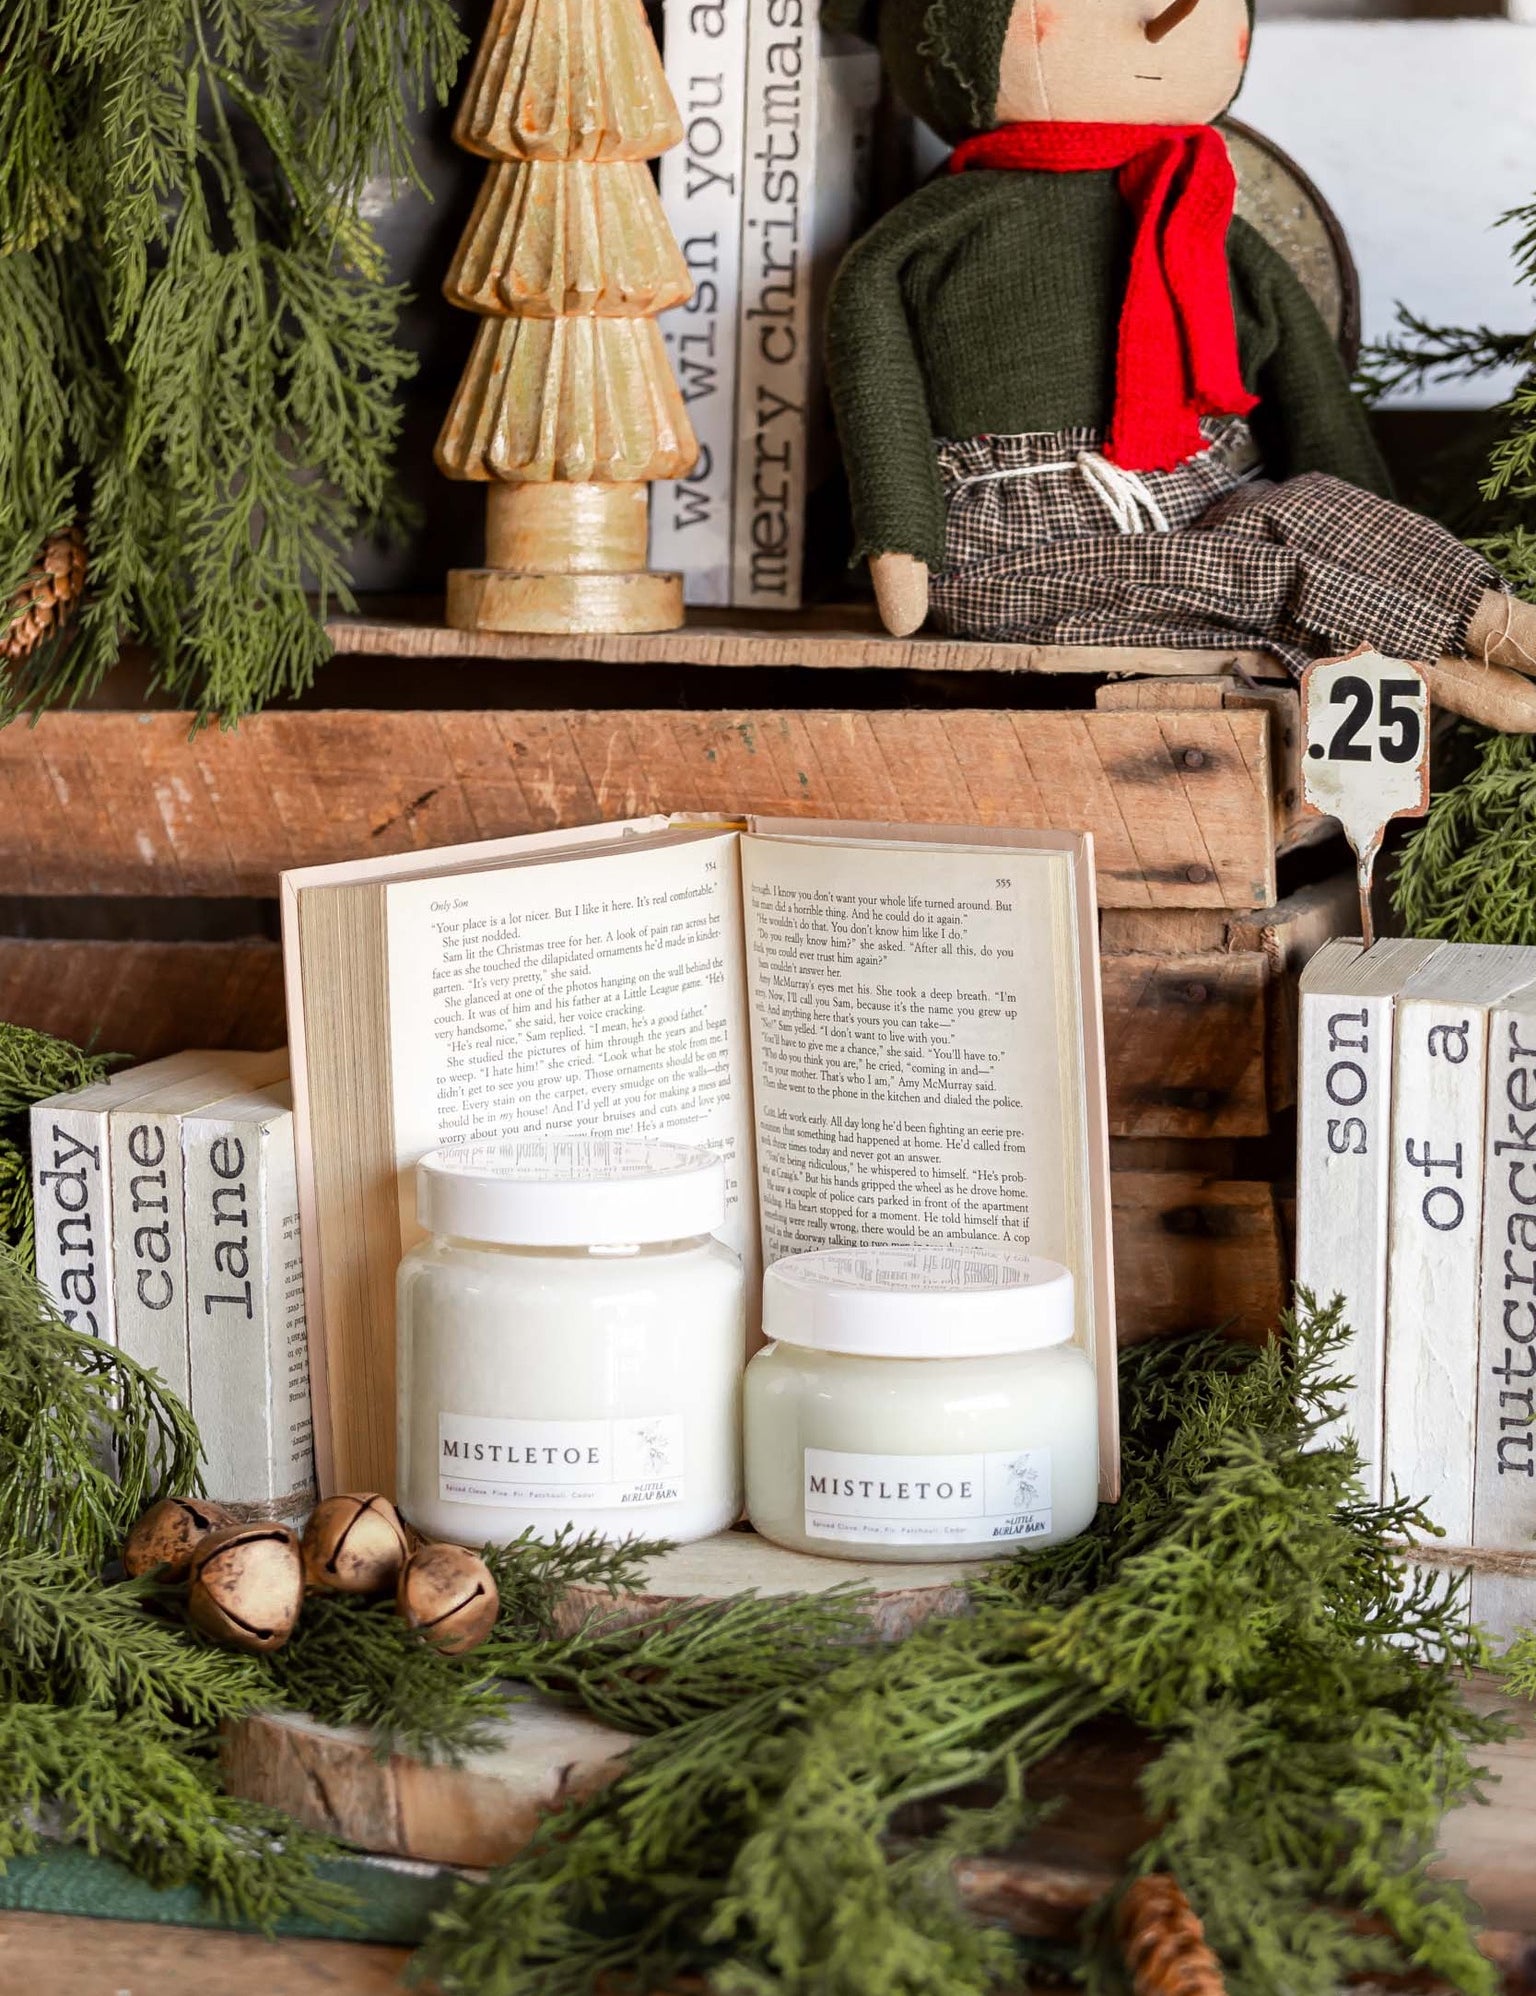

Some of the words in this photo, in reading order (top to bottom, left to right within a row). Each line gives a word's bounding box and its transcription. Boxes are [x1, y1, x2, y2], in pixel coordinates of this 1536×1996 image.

[691, 0, 725, 38] a
[686, 73, 735, 199] you
[746, 0, 803, 365] christmas
[751, 385, 804, 596] merry
[1308, 676, 1421, 764] .25
[995, 878, 1011, 889] 555
[430, 899, 452, 913] Only
[452, 898, 469, 909] Son
[462, 916, 486, 933] place
[490, 915, 497, 926] is
[500, 917, 506, 925] a
[509, 912, 521, 924] lot
[554, 906, 571, 918] But
[575, 905, 578, 916] I
[582, 902, 599, 915] like
[602, 901, 608, 912] it
[442, 935, 459, 948] She
[462, 932, 478, 948] just
[443, 950, 462, 963] Sam
[466, 948, 474, 960] lit
[478, 946, 493, 958] the
[496, 939, 543, 956] Christmas
[547, 937, 565, 949] tree
[568, 934, 582, 947] for
[606, 930, 613, 942] A
[616, 927, 636, 940] look
[638, 925, 647, 937] of
[650, 922, 668, 938] pain
[671, 922, 682, 932] ran
[806, 934, 827, 947] know
[860, 939, 874, 950] she
[941, 943, 952, 955] all
[980, 945, 992, 956] do
[996, 949, 1013, 960] you
[831, 921, 847, 933] You
[875, 924, 898, 936] know
[902, 926, 918, 938] him
[922, 927, 938, 938] like
[941, 928, 944, 939] I
[490, 977, 509, 989] very
[550, 967, 566, 979] she
[838, 982, 853, 994] met
[876, 985, 892, 996] She
[896, 986, 916, 998] took
[920, 990, 926, 998] a
[930, 988, 952, 1002] deep
[434, 1029, 453, 1042] very
[516, 1016, 530, 1028] she
[559, 1010, 574, 1023] her
[578, 1007, 602, 1021] voice
[1428, 1020, 1469, 1064] a
[817, 1084, 830, 1096] the
[832, 1086, 858, 1101] phone
[860, 1088, 868, 1099] in
[871, 1089, 884, 1100] the
[887, 1090, 920, 1102] kitchen
[923, 1092, 940, 1103] and
[944, 1093, 972, 1105] dialed
[975, 1094, 990, 1106] the
[846, 1072, 865, 1084] who
[867, 1074, 872, 1085] I
[898, 1076, 919, 1090] Amy
[922, 1077, 972, 1093] McMurray
[1326, 1008, 1369, 1154] son
[439, 1132, 465, 1147] worry
[470, 1125, 496, 1139] about
[502, 1125, 518, 1138] you
[523, 1119, 541, 1132] and
[546, 1119, 572, 1129] nurse
[576, 1116, 597, 1128] your
[602, 1107, 635, 1122] bruises
[640, 1104, 656, 1117] and
[660, 1100, 676, 1114] cuts
[818, 1188, 827, 1200] of
[830, 1189, 854, 1205] police
[857, 1195, 874, 1204] cars
[877, 1194, 908, 1209] parked
[912, 1196, 921, 1207] in
[924, 1196, 947, 1208] front
[950, 1198, 960, 1209] of
[964, 1198, 978, 1210] the
[982, 1199, 1028, 1215] apartment
[1405, 1137, 1464, 1231] of
[128, 1124, 173, 1311] cane
[205, 1136, 253, 1319] lane
[1492, 1021, 1536, 1477] nutcracker
[443, 1439, 600, 1464] MISTLETOE
[810, 1475, 973, 1499] MISTLETOE
